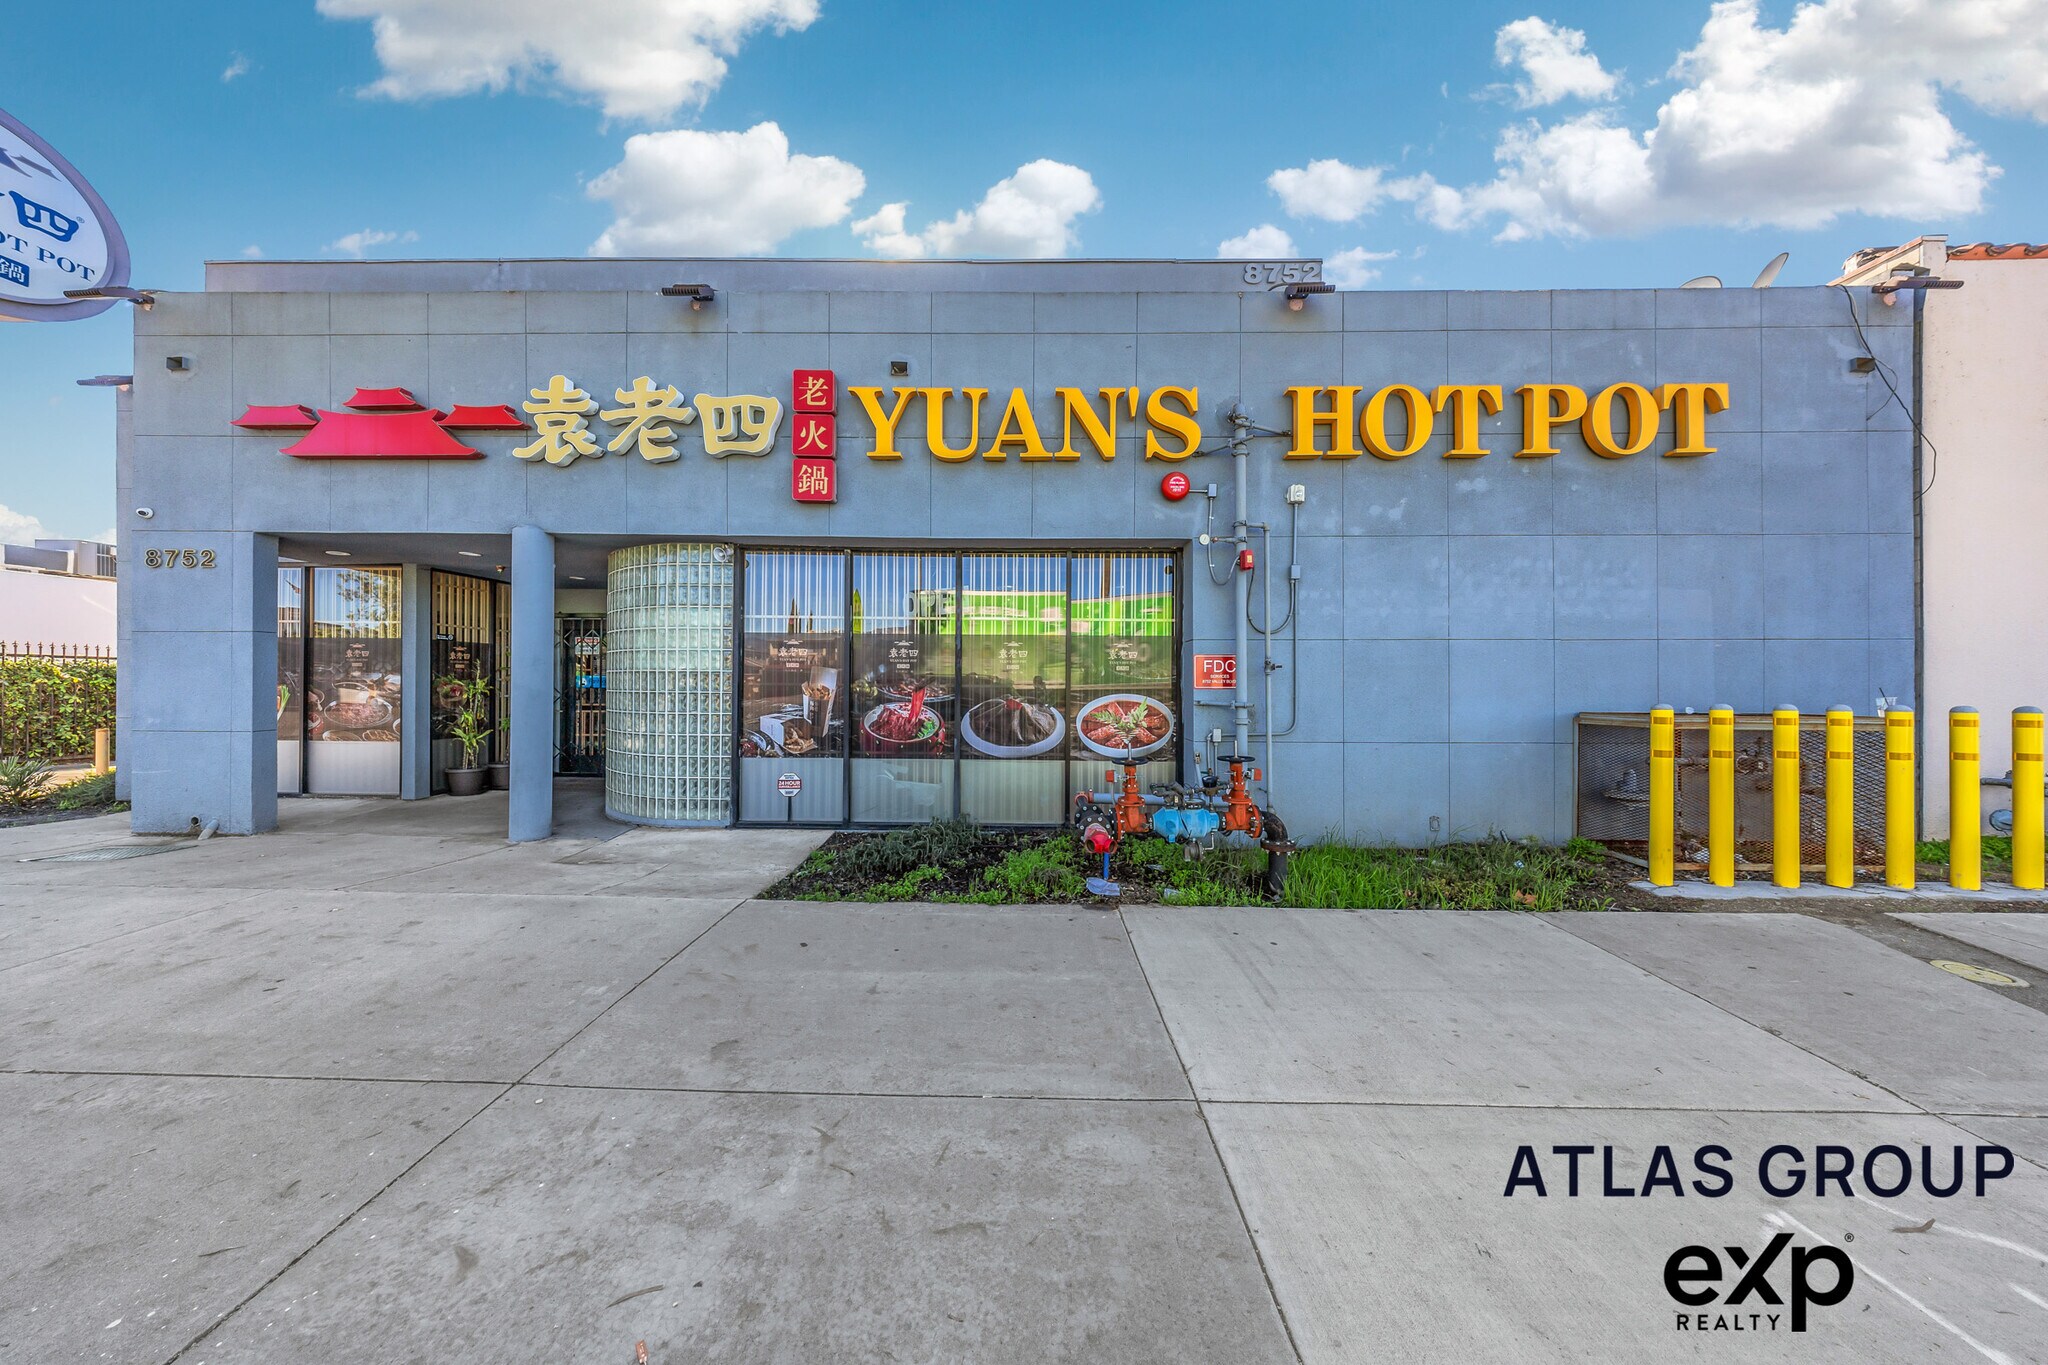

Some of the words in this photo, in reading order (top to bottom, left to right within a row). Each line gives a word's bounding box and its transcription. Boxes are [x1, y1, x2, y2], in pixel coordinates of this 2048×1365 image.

[0, 190, 79, 242] 四
[36, 246, 95, 281] POT
[1244, 262, 1321, 285] 8752
[512, 374, 784, 466] 袁老四
[798, 376, 829, 494] 老火鍋
[848, 385, 1201, 462] YUAN'S
[1283, 383, 1503, 460] HOT
[1514, 382, 1729, 459] POT
[144, 548, 217, 568] 8752
[888, 647, 919, 658] 袁老四
[1203, 660, 1236, 673] FDC
